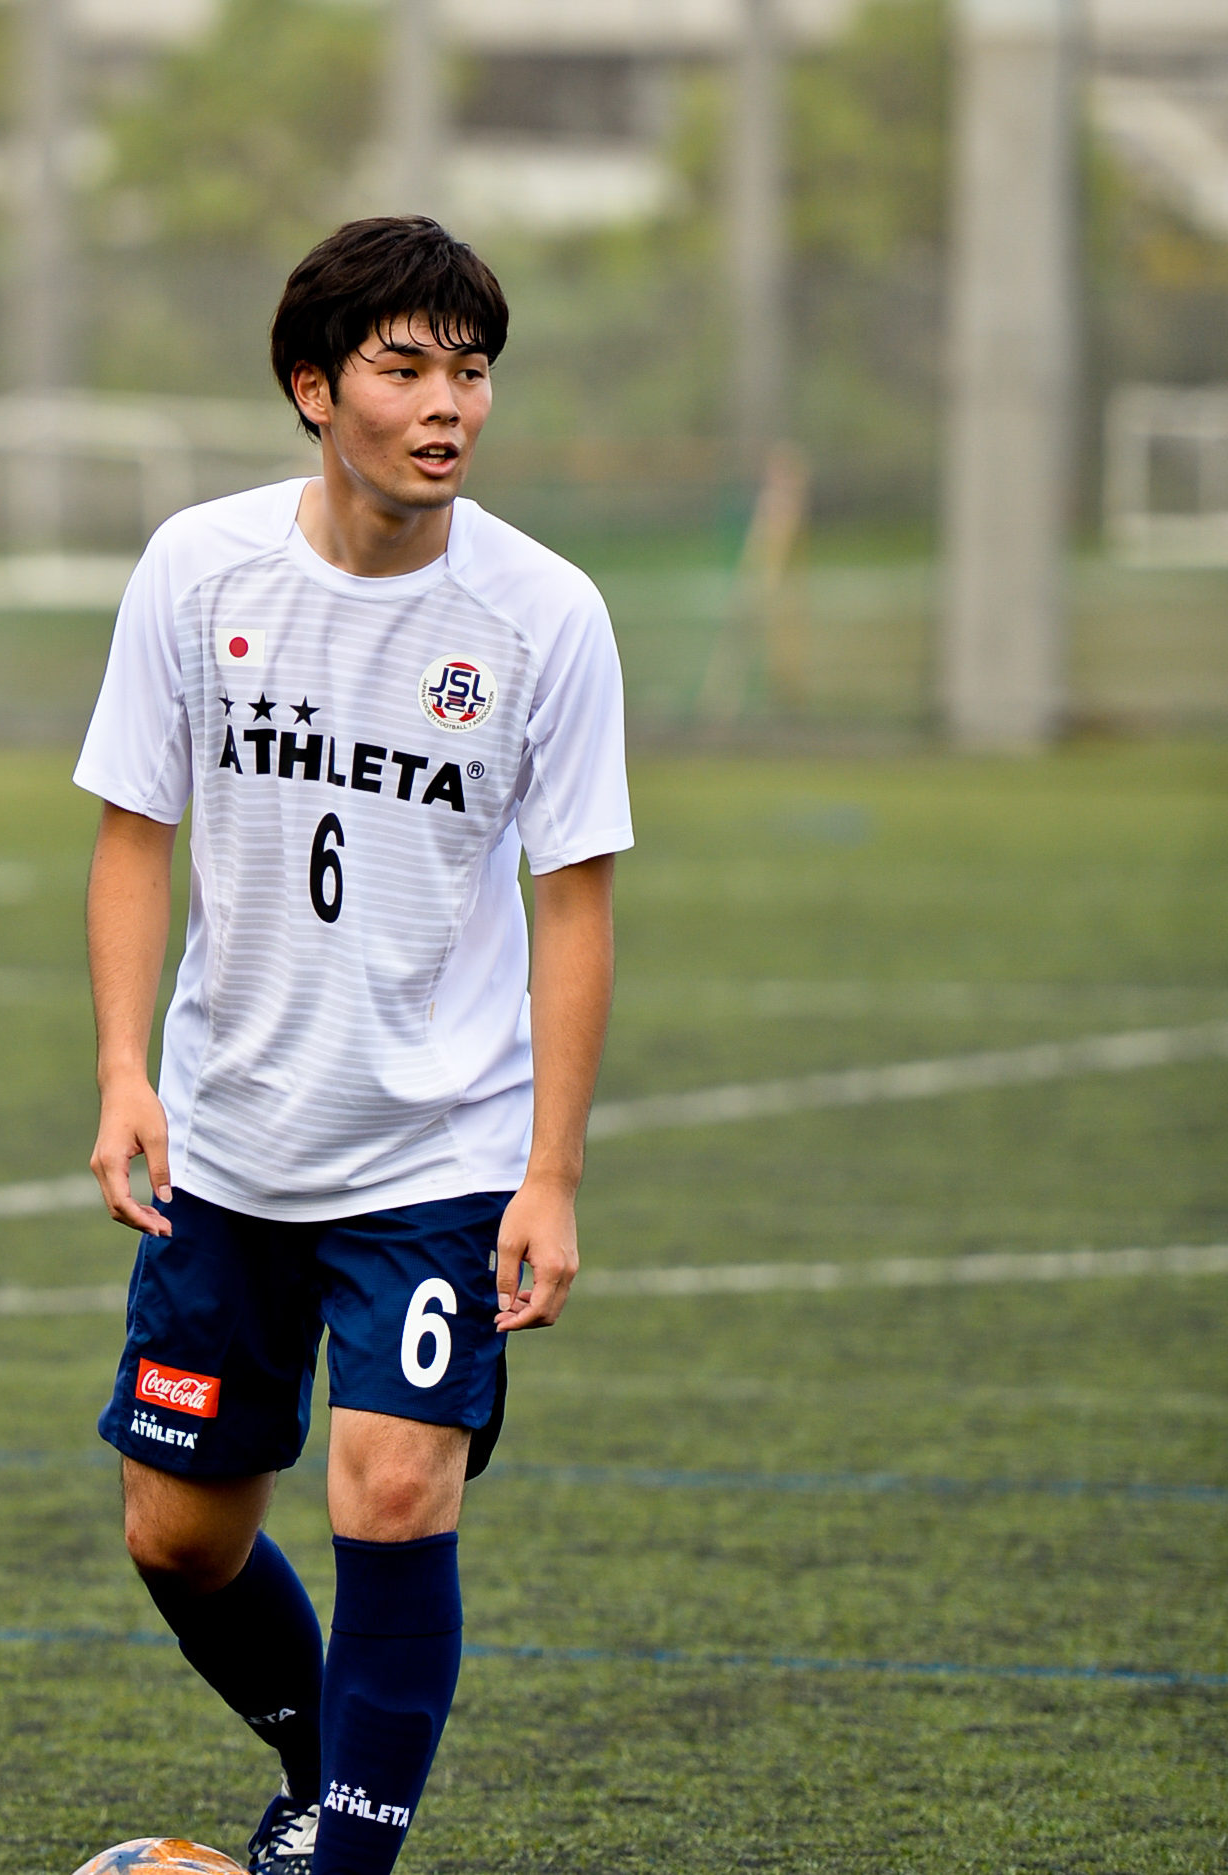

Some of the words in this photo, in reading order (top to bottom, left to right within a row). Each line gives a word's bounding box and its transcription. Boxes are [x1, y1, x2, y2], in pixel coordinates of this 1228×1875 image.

[428, 667, 486, 703] JSL
[436, 719, 467, 730] FOOTBALL
[309, 812, 345, 924] 6
[400, 1277, 458, 1388] 6
[141, 1368, 213, 1410] Coca-Cola
[130, 1418, 198, 1449] ATHLETA
[323, 1790, 410, 1828] ATHLETA
